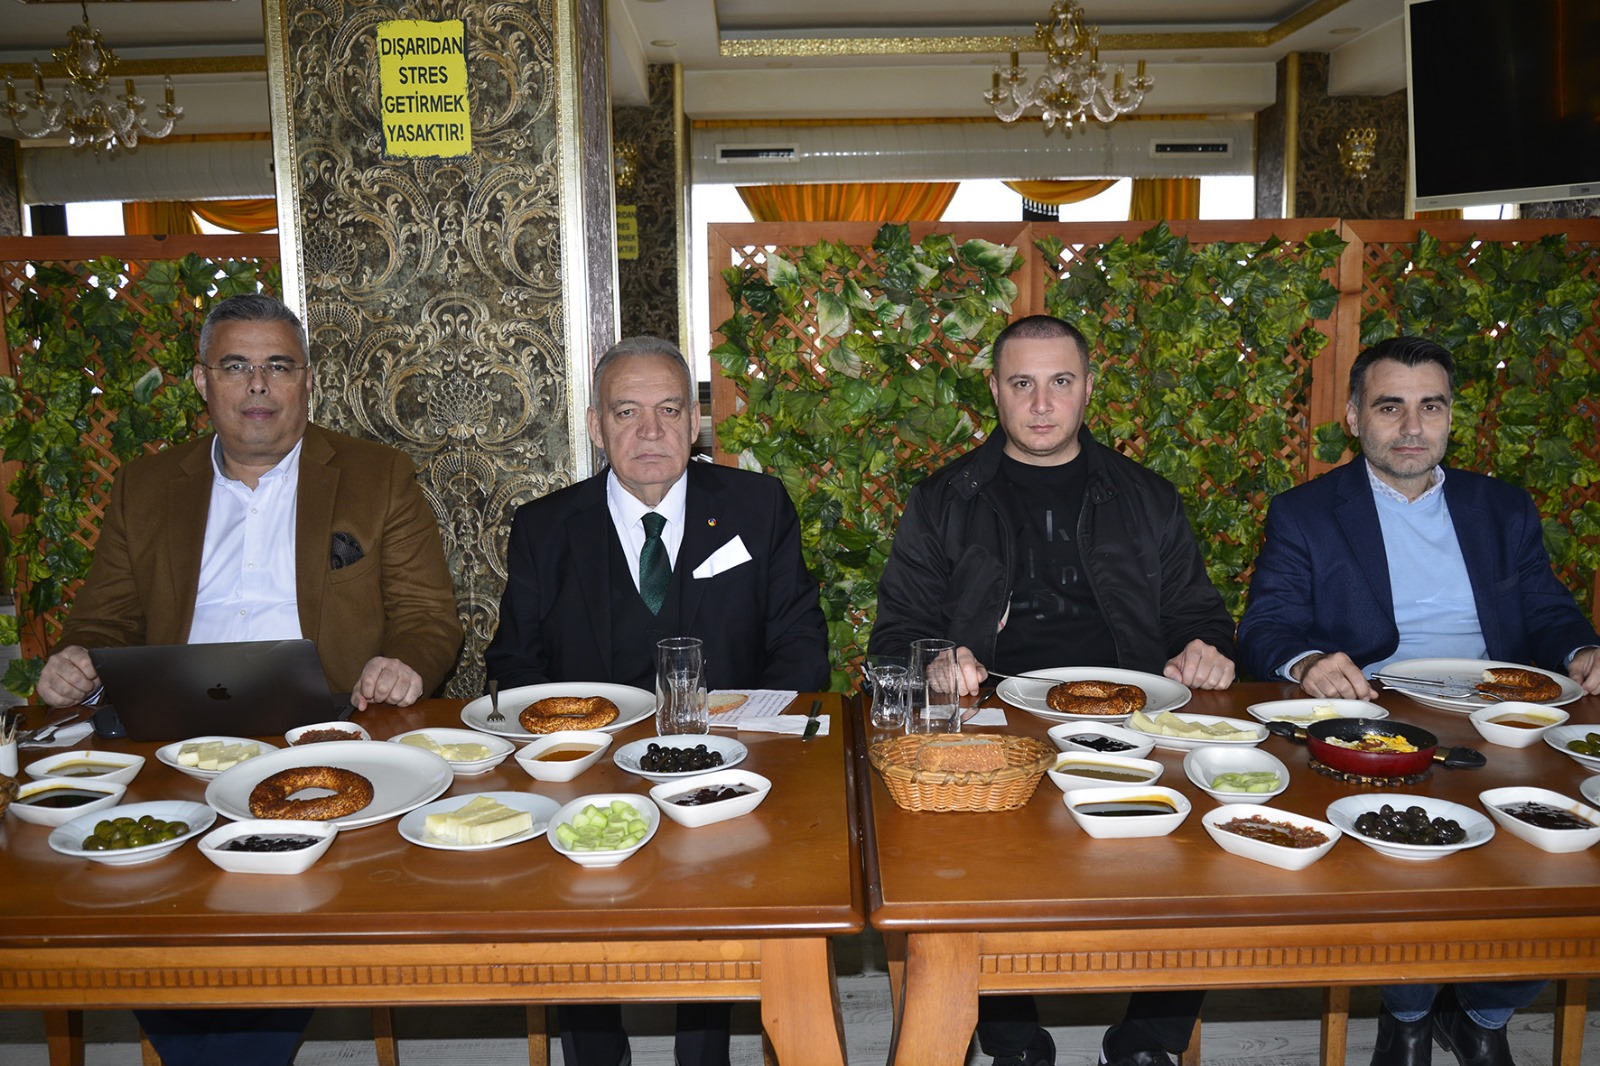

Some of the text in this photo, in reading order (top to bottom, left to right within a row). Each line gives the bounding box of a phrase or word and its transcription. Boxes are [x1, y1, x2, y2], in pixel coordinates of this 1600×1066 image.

[381, 36, 463, 60] DIŞARIDAN
[399, 66, 448, 84] STRES
[385, 91, 465, 113] GETİRMEK
[387, 123, 464, 141] YASAKTIR!
